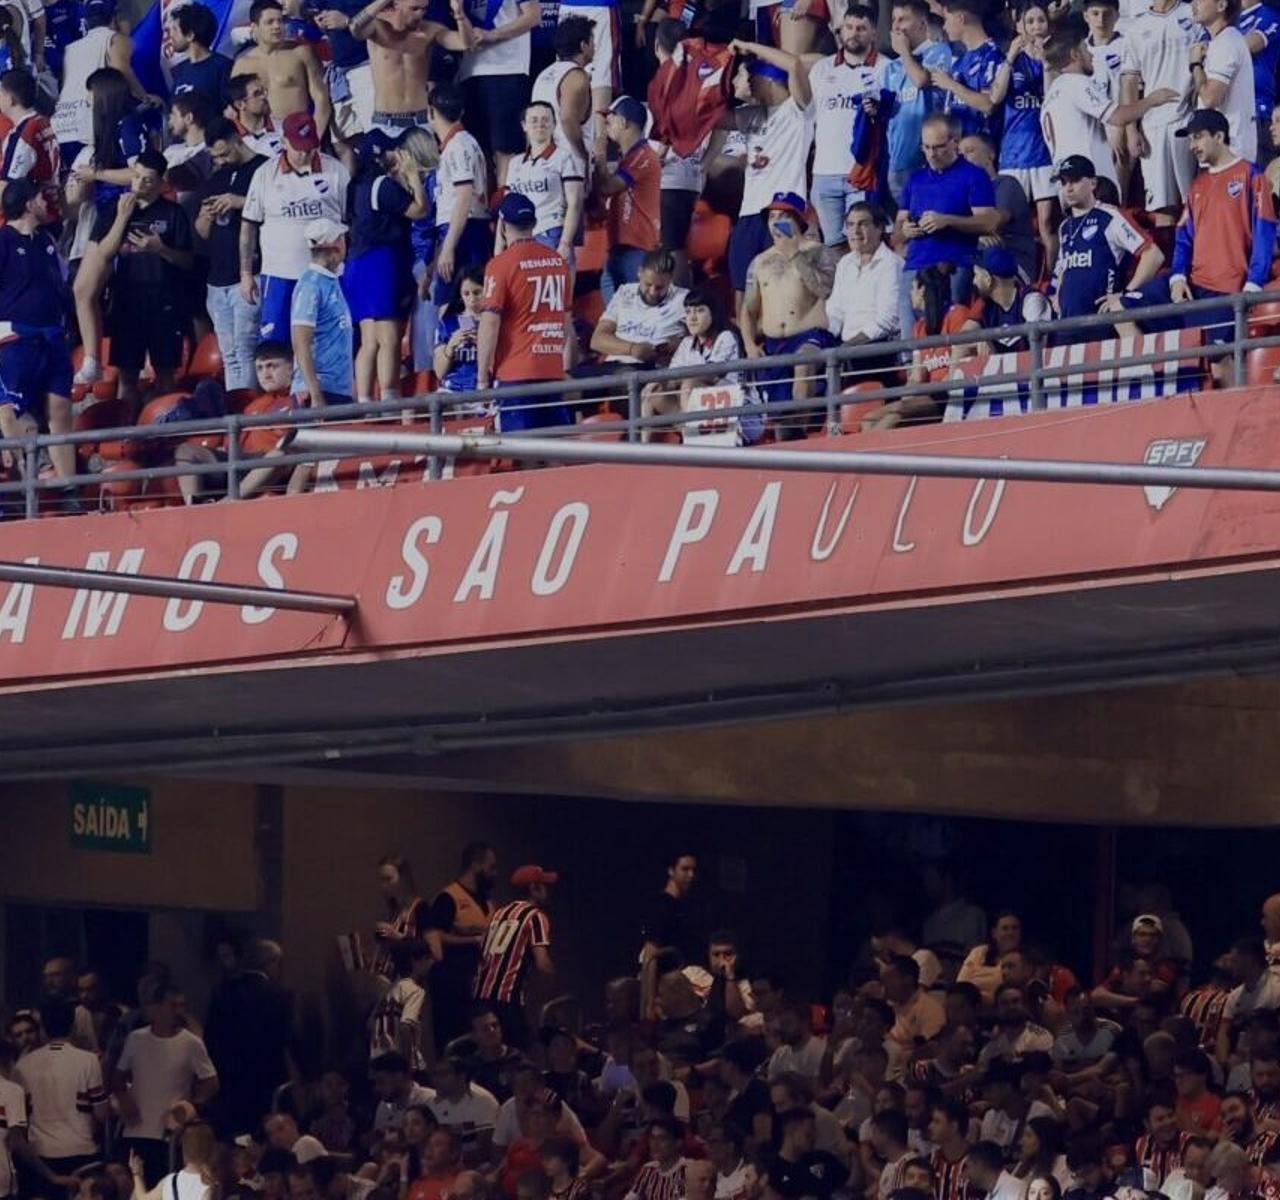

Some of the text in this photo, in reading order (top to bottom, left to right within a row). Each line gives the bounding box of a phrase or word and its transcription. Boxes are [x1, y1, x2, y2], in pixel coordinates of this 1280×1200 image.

[281, 200, 324, 218] antel
[387, 486, 591, 611] SÃO
[73, 799, 131, 840] SAÍDA
